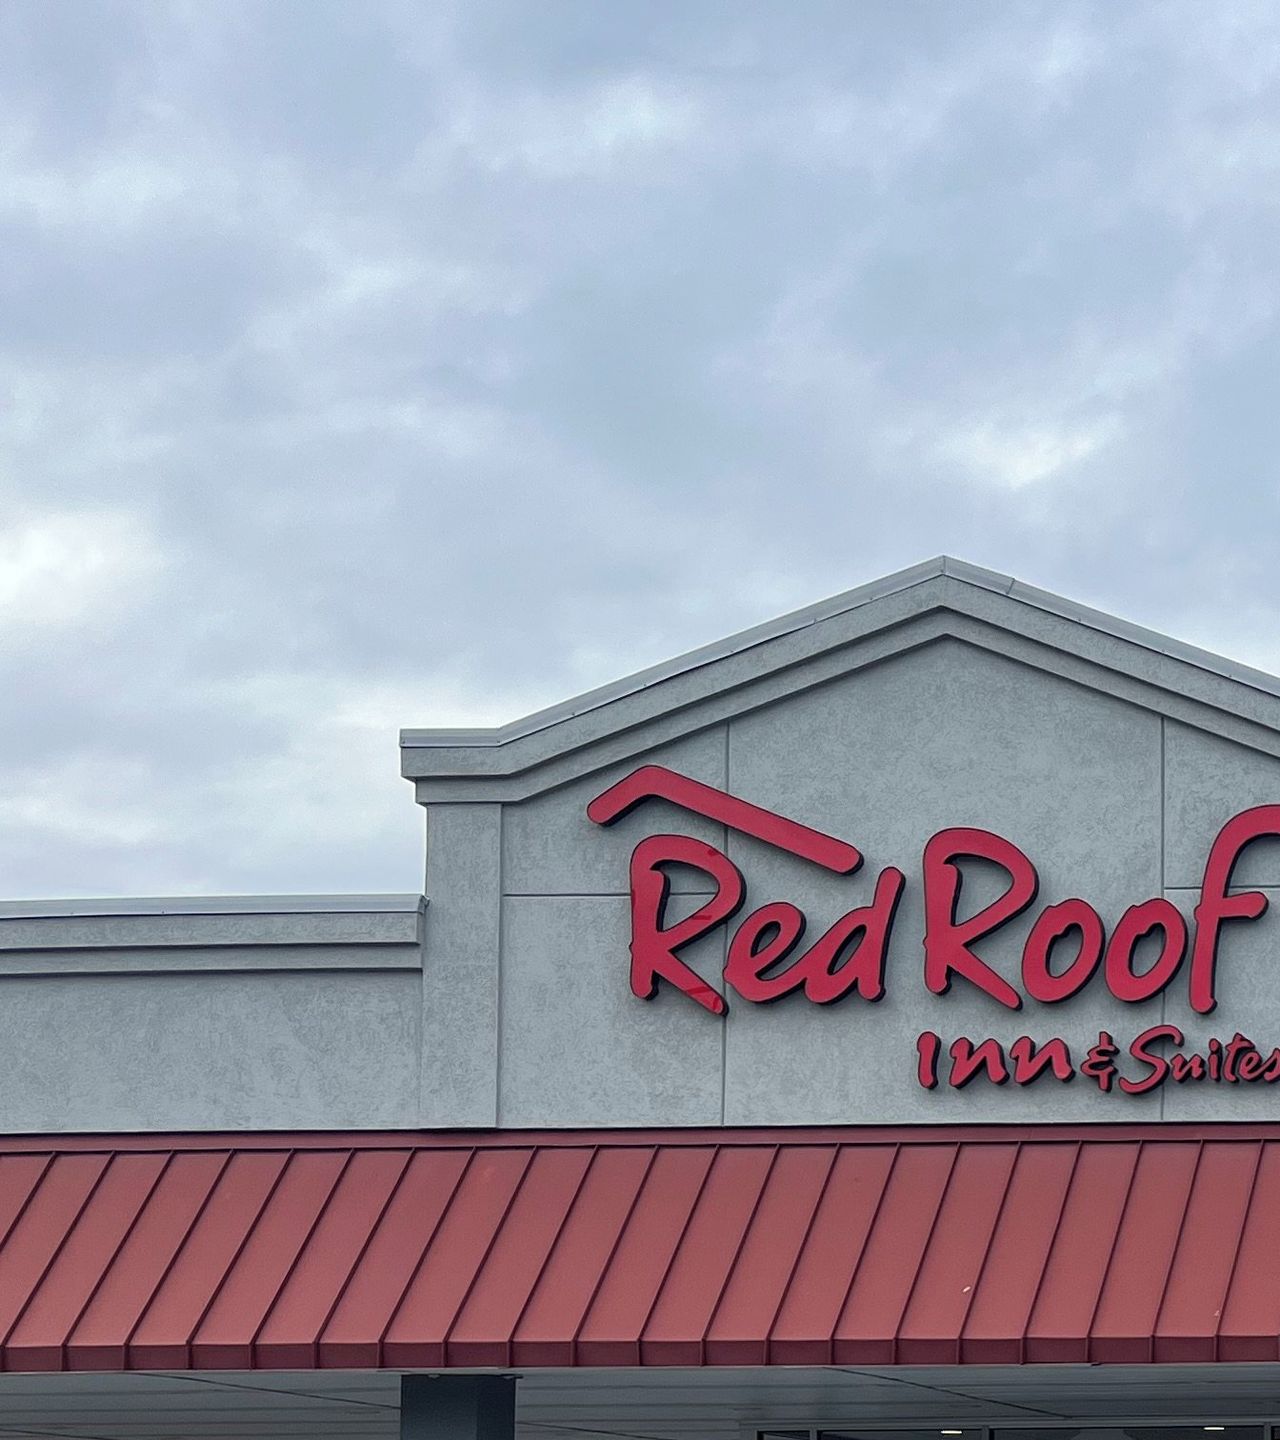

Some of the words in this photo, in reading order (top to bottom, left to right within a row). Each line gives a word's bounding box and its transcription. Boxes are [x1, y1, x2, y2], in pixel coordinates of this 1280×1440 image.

[628, 834, 906, 1015] Red
[917, 1031, 1076, 1090] Inn
[1081, 1031, 1116, 1092] &
